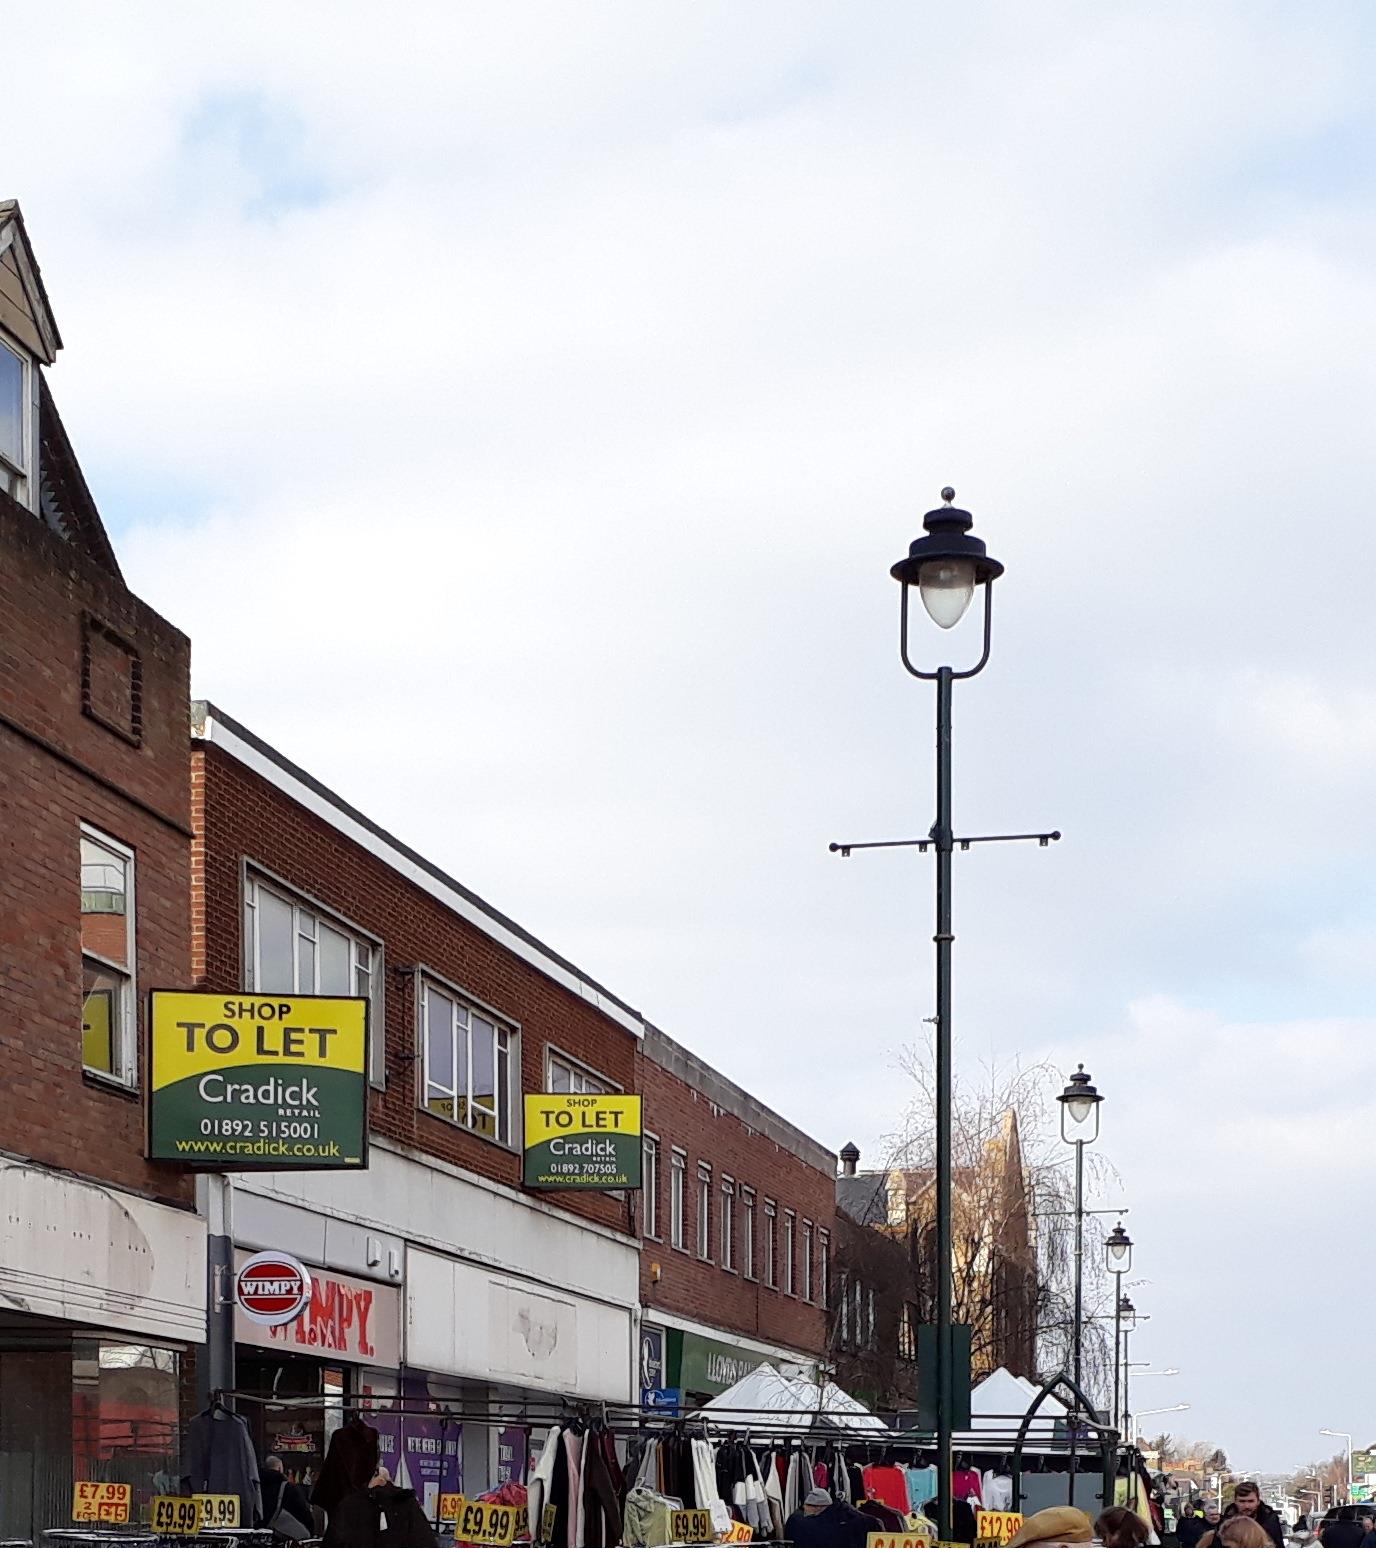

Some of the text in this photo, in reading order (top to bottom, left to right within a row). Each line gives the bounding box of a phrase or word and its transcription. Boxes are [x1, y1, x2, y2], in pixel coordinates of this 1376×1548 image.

[223, 1001, 292, 1021] SHOP
[176, 1021, 338, 1058] TO LET
[198, 1074, 320, 1106] Cradick
[566, 1098, 598, 1108] SHOP
[277, 1108, 321, 1118] RETAIL
[539, 1110, 625, 1129] TO LET
[200, 1119, 319, 1139] 01892 515001
[176, 1139, 341, 1157] www.cradick.co.uk
[549, 1139, 617, 1156] Cradick
[550, 1164, 617, 1174] 01892 707505
[538, 1174, 628, 1184] www.cradick.co.uk
[78, 1483, 127, 1501] £7.99
[83, 1501, 92, 1510] 2
[156, 1501, 196, 1530] £9.99
[462, 1508, 510, 1541] £9.99
[675, 1512, 708, 1539] £9.99
